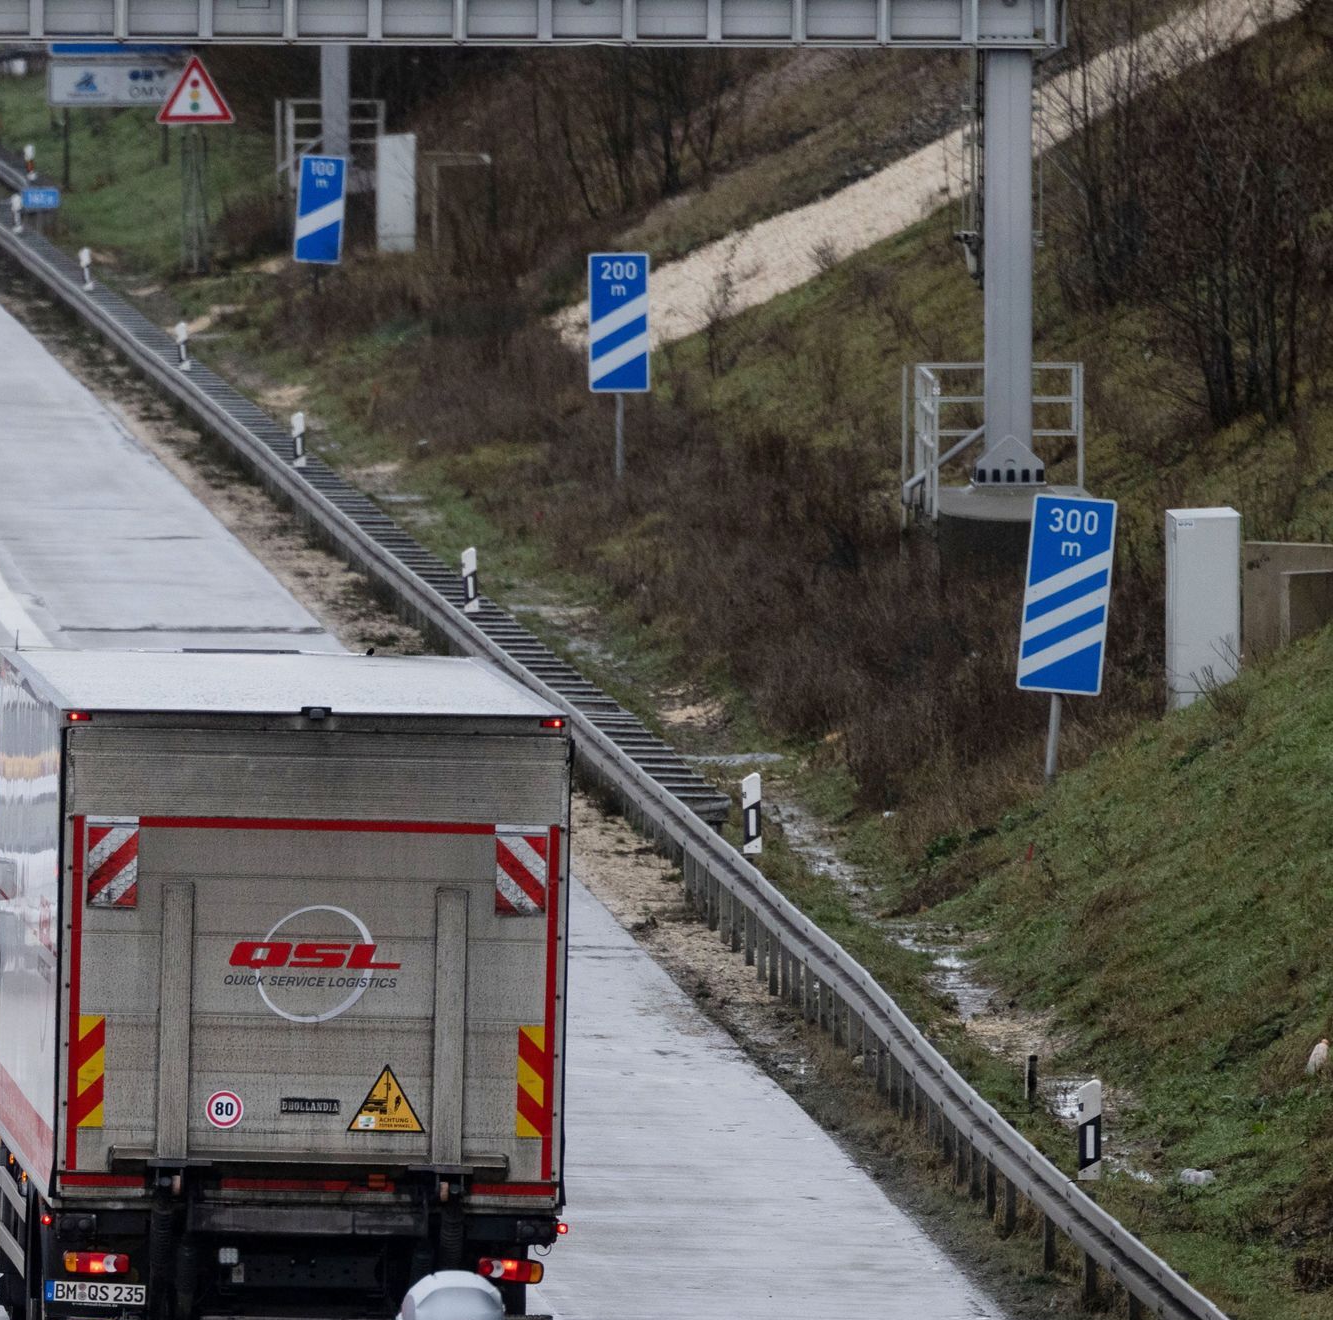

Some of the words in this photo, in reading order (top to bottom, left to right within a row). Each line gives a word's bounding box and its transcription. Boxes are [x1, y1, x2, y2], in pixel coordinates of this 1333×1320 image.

[311, 160, 336, 177] 100
[315, 178, 329, 189] m
[600, 261, 637, 280] 200
[610, 284, 627, 297] m
[1048, 507, 1099, 536] 300
[1061, 541, 1081, 557] m
[228, 941, 402, 970] QSL
[223, 974, 267, 987] QUICK
[269, 975, 326, 988] SERVICE
[328, 976, 398, 989] LOGISTICS
[214, 1101, 233, 1117] 80
[281, 1100, 339, 1112] DHOLLANDIA
[55, 1283, 77, 1300] BM
[88, 1284, 110, 1301] QS
[113, 1286, 144, 1303] 235
